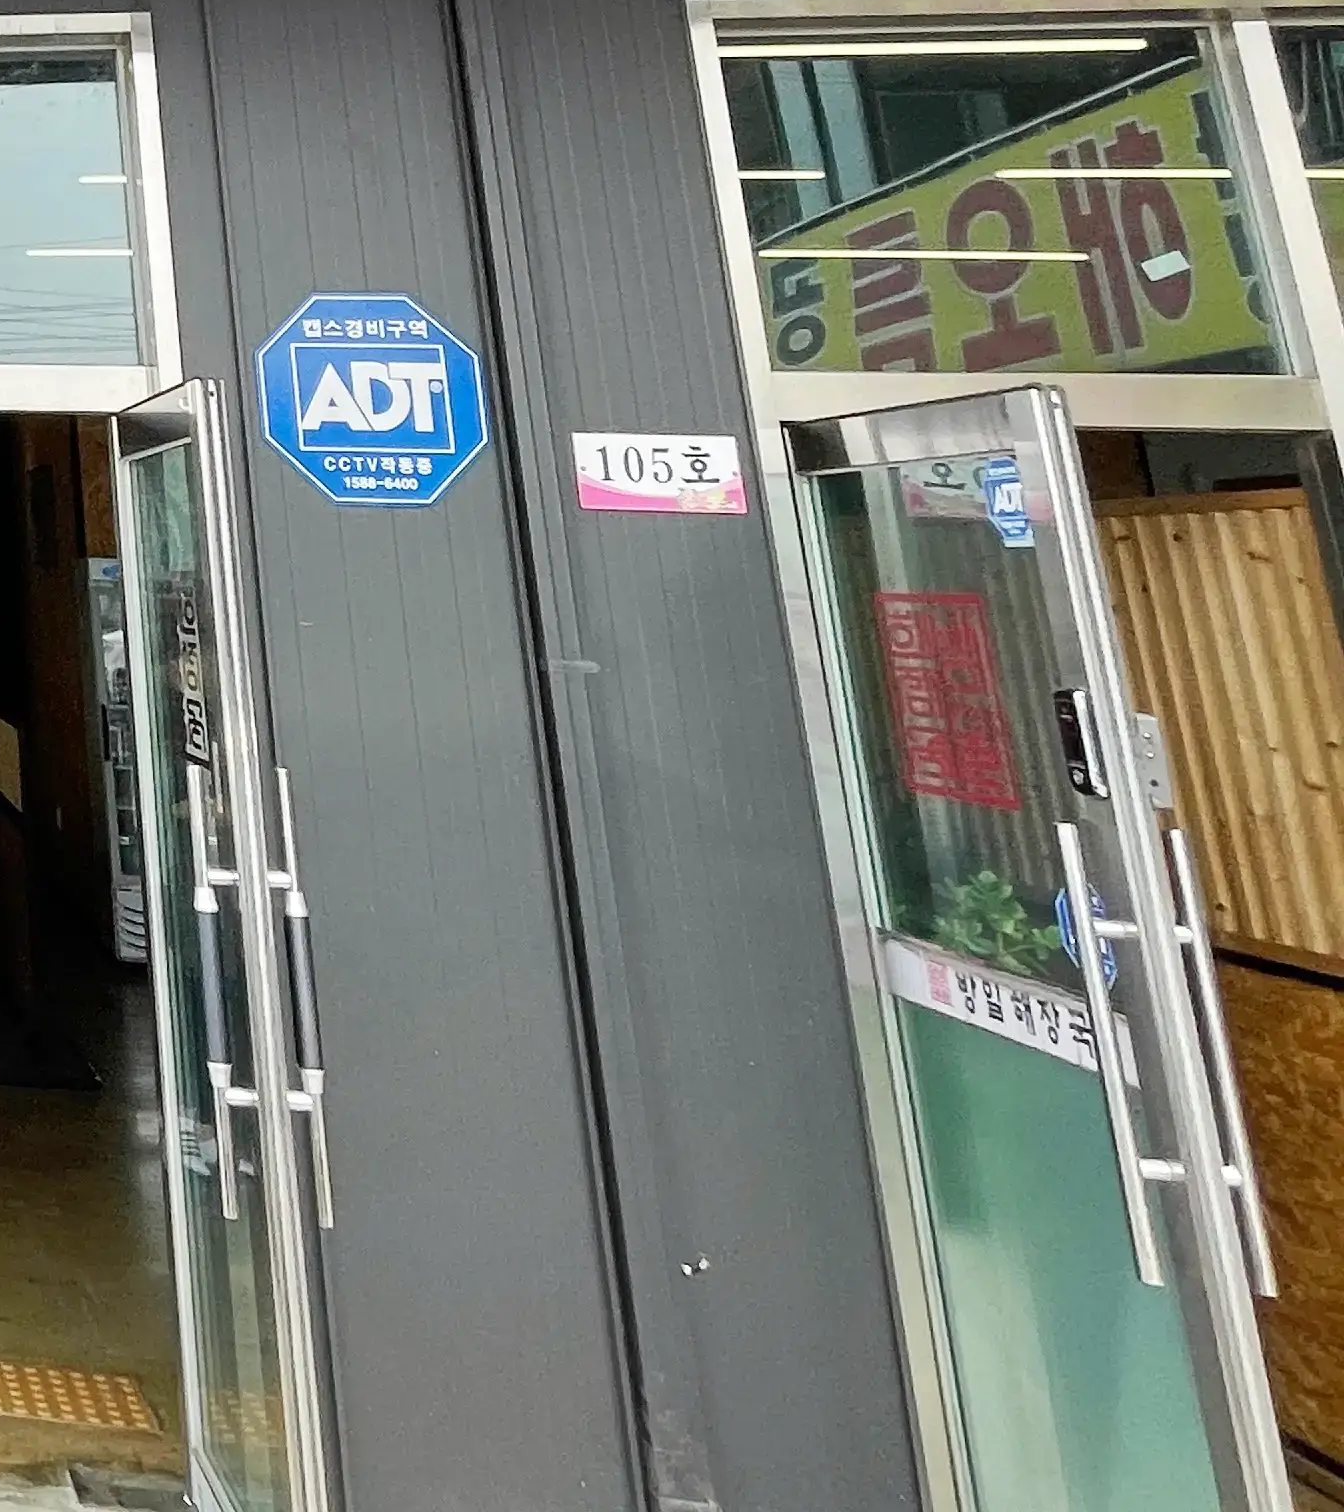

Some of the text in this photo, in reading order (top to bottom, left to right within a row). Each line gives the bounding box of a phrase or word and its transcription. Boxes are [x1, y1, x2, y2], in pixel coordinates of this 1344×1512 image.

[303, 319, 429, 338] 캡스경비구역
[302, 361, 444, 432] ADT
[323, 456, 432, 475] CCTV작동중
[596, 445, 720, 485] 105호
[343, 476, 419, 490] 1588-6400
[956, 971, 1096, 1058] 방일해장국
